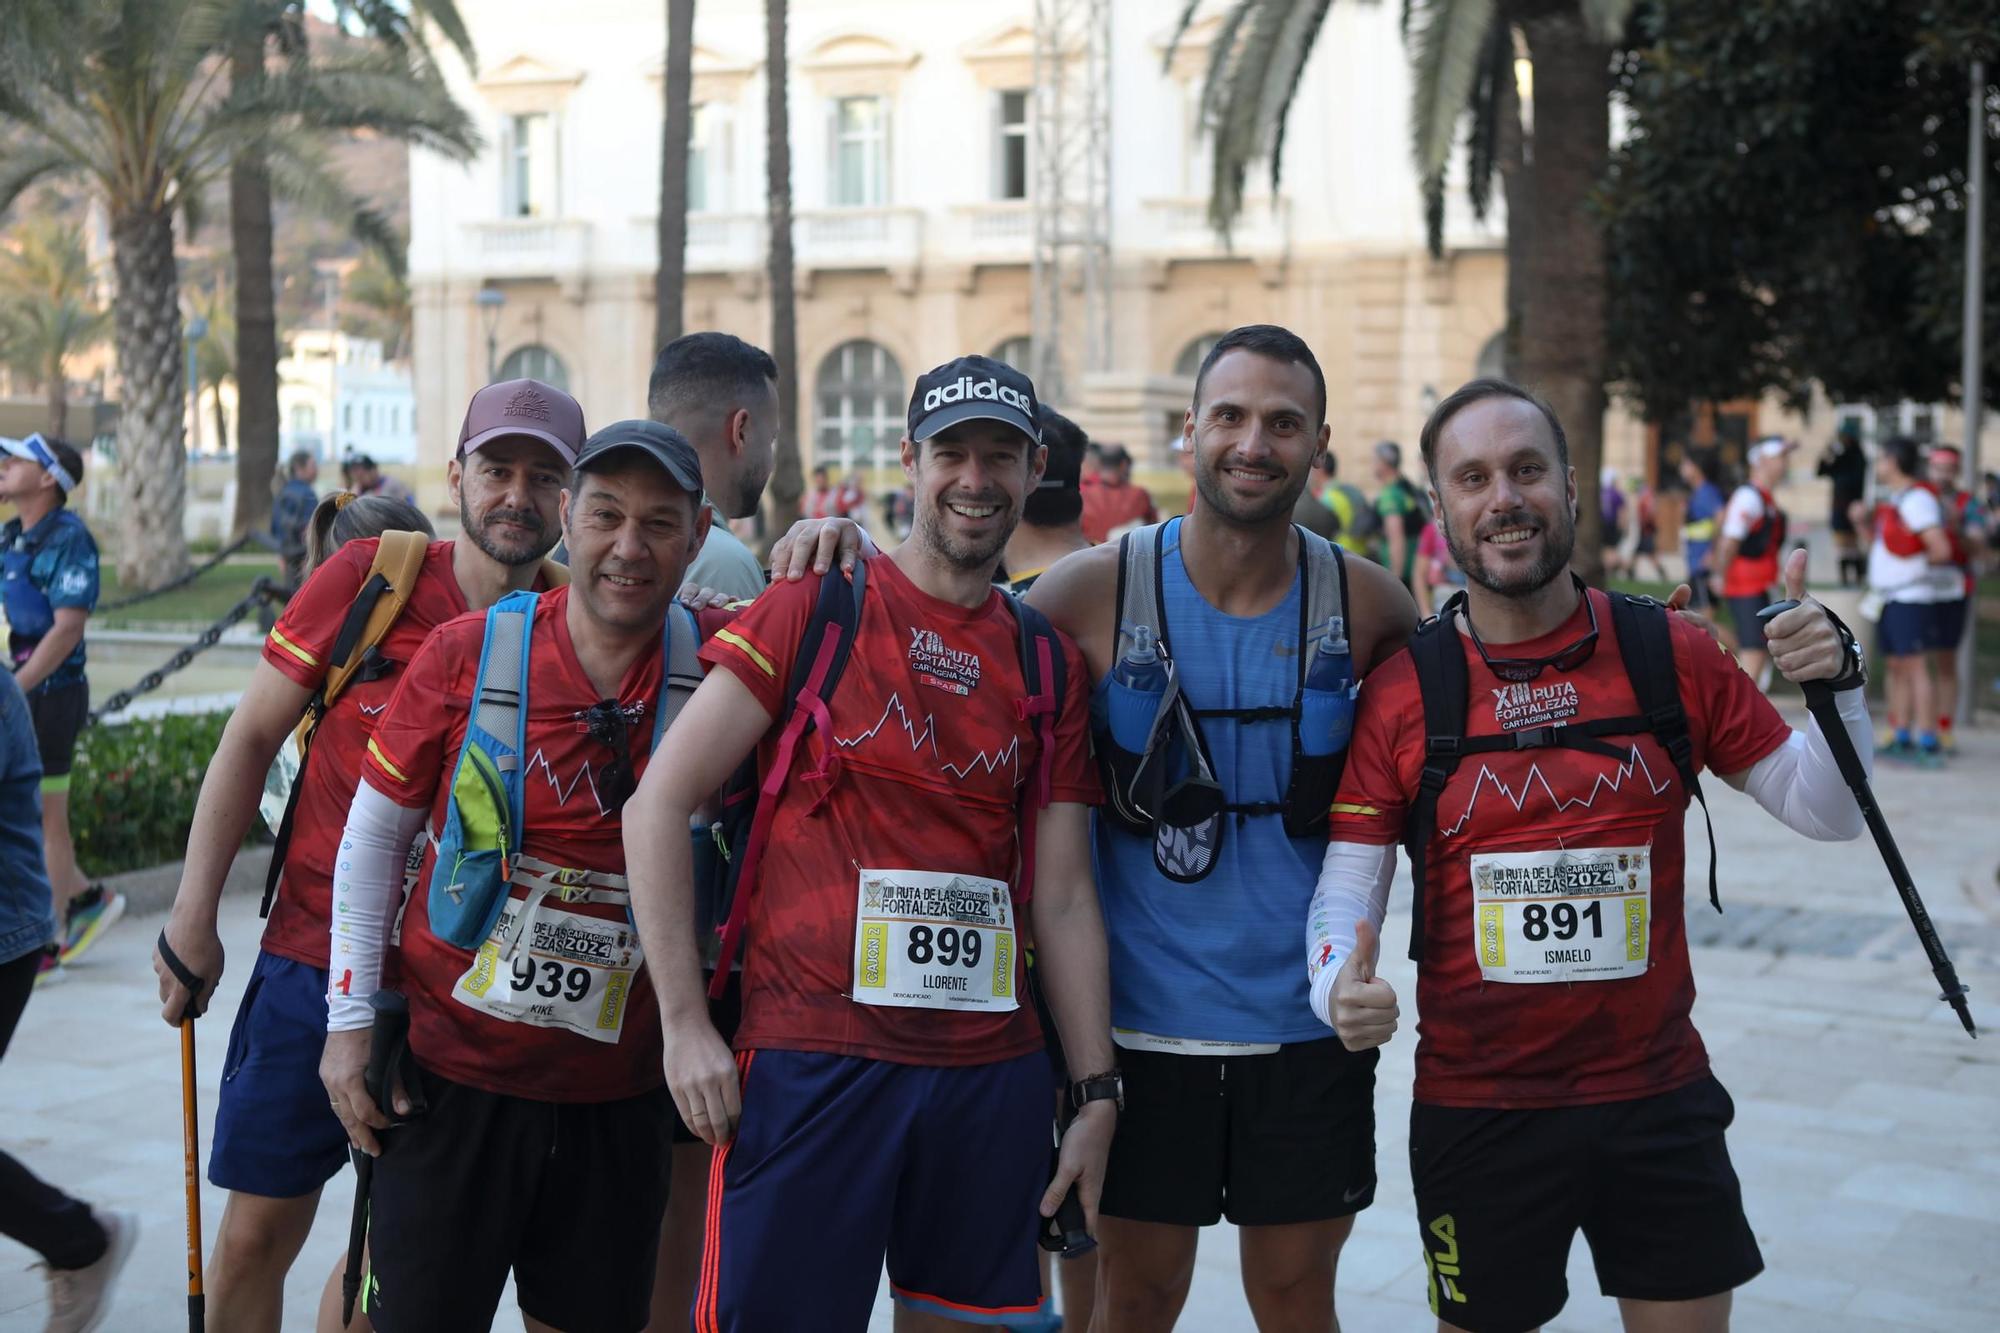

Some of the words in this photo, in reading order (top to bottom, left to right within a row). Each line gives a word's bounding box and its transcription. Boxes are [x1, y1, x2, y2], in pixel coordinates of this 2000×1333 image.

[923, 376, 1032, 418] adidas
[910, 626, 944, 656] XIII
[945, 647, 980, 669] RUTA
[908, 649, 981, 679] FORTALEZAS
[912, 662, 958, 680] CARTAGENA
[1491, 681, 1532, 711] XIII
[1532, 681, 1577, 702] RUTA
[1495, 694, 1579, 722] FORTALEZAS
[1502, 713, 1553, 730] CARTAGENA
[1553, 707, 1576, 719] 2024
[1493, 869, 1505, 881] XIII
[1506, 867, 1531, 880] RUTA
[1532, 867, 1546, 879] DE
[1547, 866, 1567, 879] LAS
[1566, 864, 1614, 874] CARTAGENA
[1494, 879, 1567, 896] FORTALEZAS
[1567, 872, 1615, 887] 2024
[882, 886, 895, 899] XIII
[896, 887, 921, 901] RUTA
[923, 888, 936, 901] DE
[938, 889, 956, 902] LAS
[956, 890, 990, 901] CARTAGENA
[881, 899, 957, 917] FORTALEZAS
[956, 900, 990, 916] 2024
[1522, 900, 1603, 942] 891
[534, 922, 547, 935] DE
[548, 925, 568, 940] LAS
[567, 928, 613, 945] CARTAGENA
[868, 927, 881, 935] 2
[565, 936, 612, 958] 2024
[907, 925, 982, 968] 899
[1544, 948, 1592, 964] ISMAELO
[510, 956, 592, 1003] 939
[923, 974, 969, 991] LLORENTE
[530, 1003, 554, 1016] KIKE
[1428, 1213, 1467, 1304] FILA
